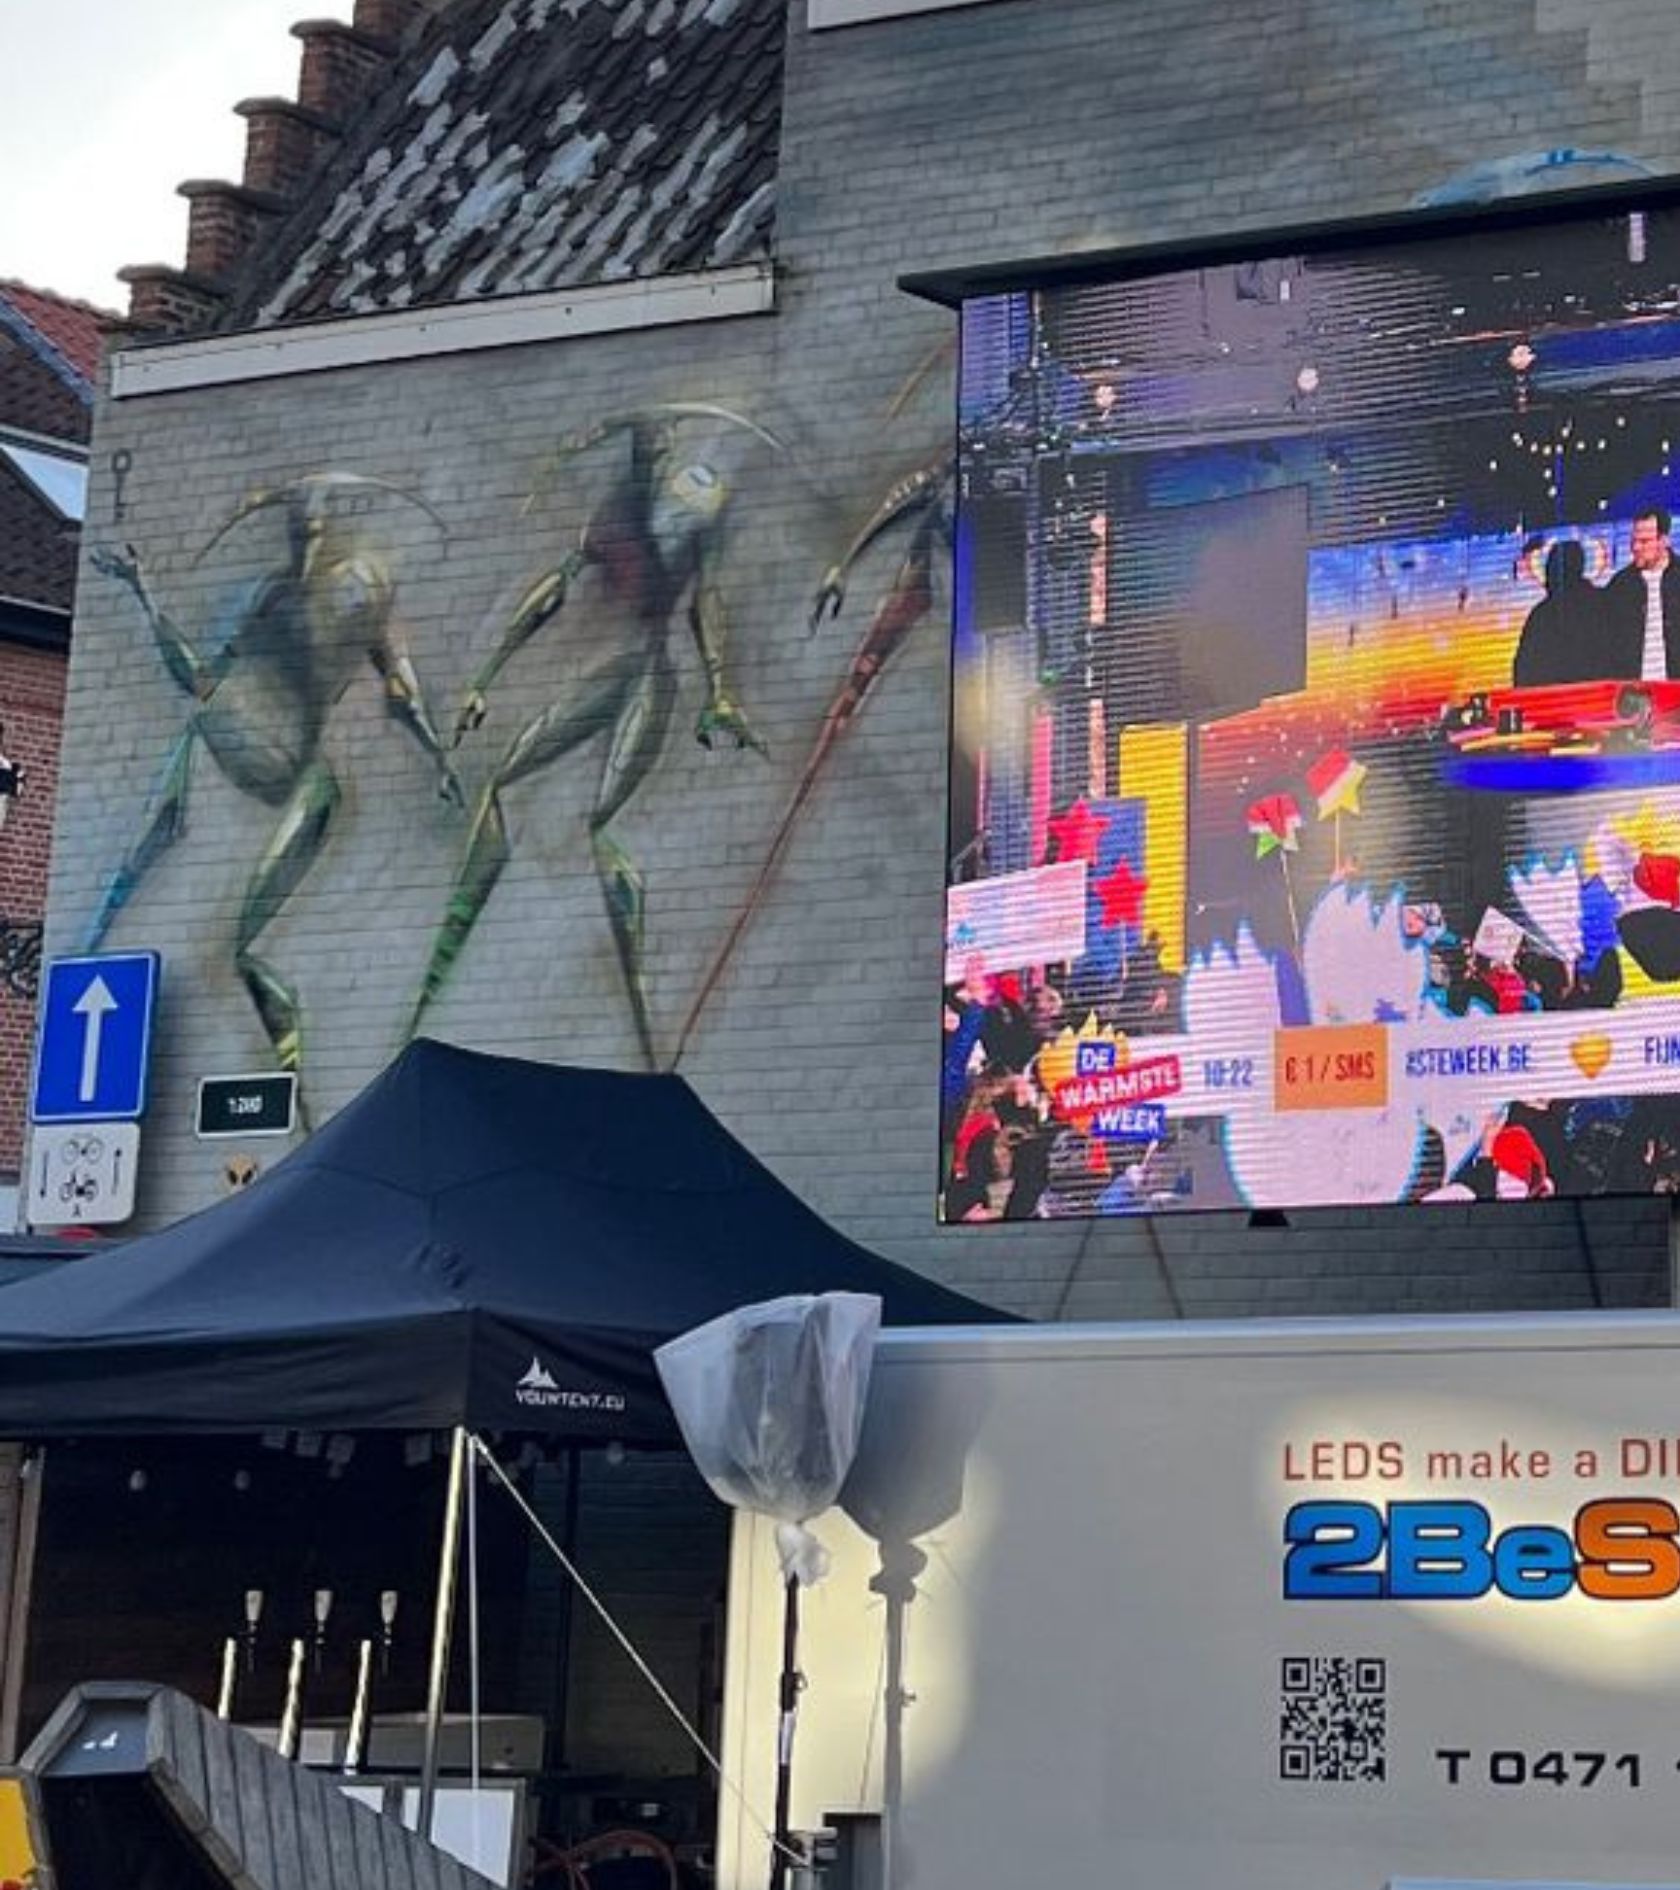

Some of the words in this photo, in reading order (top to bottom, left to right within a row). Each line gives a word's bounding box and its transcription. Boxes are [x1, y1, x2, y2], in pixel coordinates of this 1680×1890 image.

[1080, 1048, 1111, 1073] DE
[1335, 1051, 1375, 1081] SMS
[1060, 1064, 1177, 1109] WARMSTE
[1099, 1106, 1161, 1133] WEEK
[1284, 1442, 1404, 1481] LEDS
[1428, 1441, 1551, 1479] make
[1575, 1451, 1599, 1478] a
[1436, 1750, 1471, 1784] T
[1489, 1751, 1641, 1787] 0471
